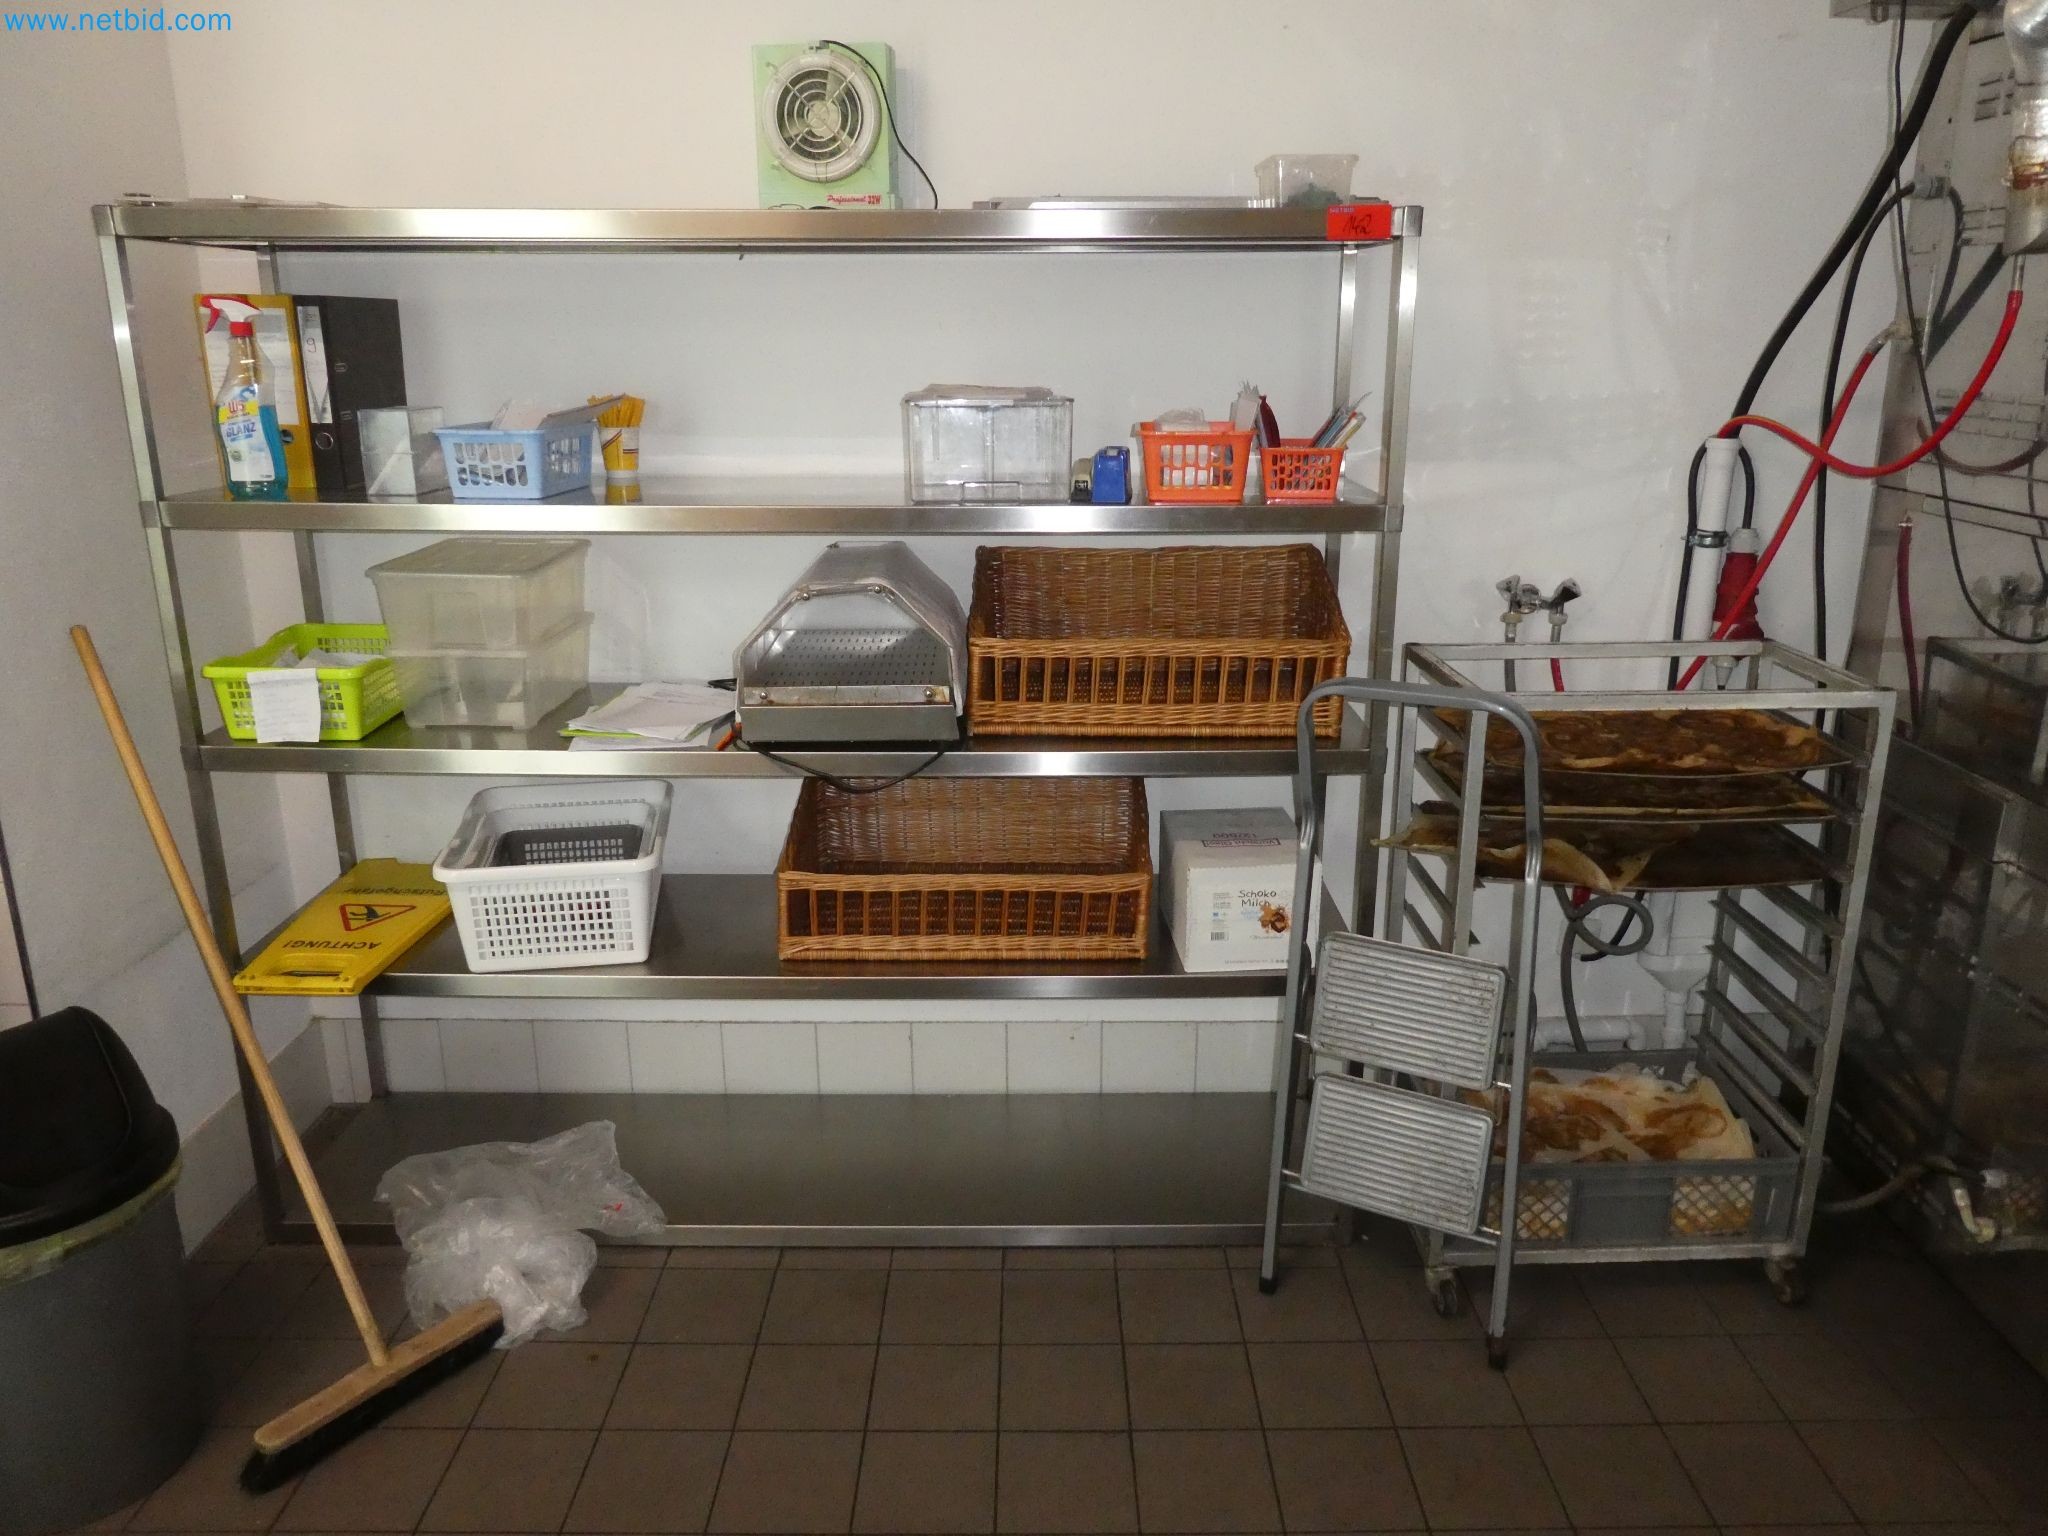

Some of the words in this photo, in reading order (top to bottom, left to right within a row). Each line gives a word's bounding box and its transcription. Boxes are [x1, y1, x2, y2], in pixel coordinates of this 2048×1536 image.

[226, 421, 257, 438] GLANZ
[1238, 889, 1277, 898] Schoko
[1241, 898, 1271, 908] Milch
[282, 940, 383, 951] ACHTUNG!
